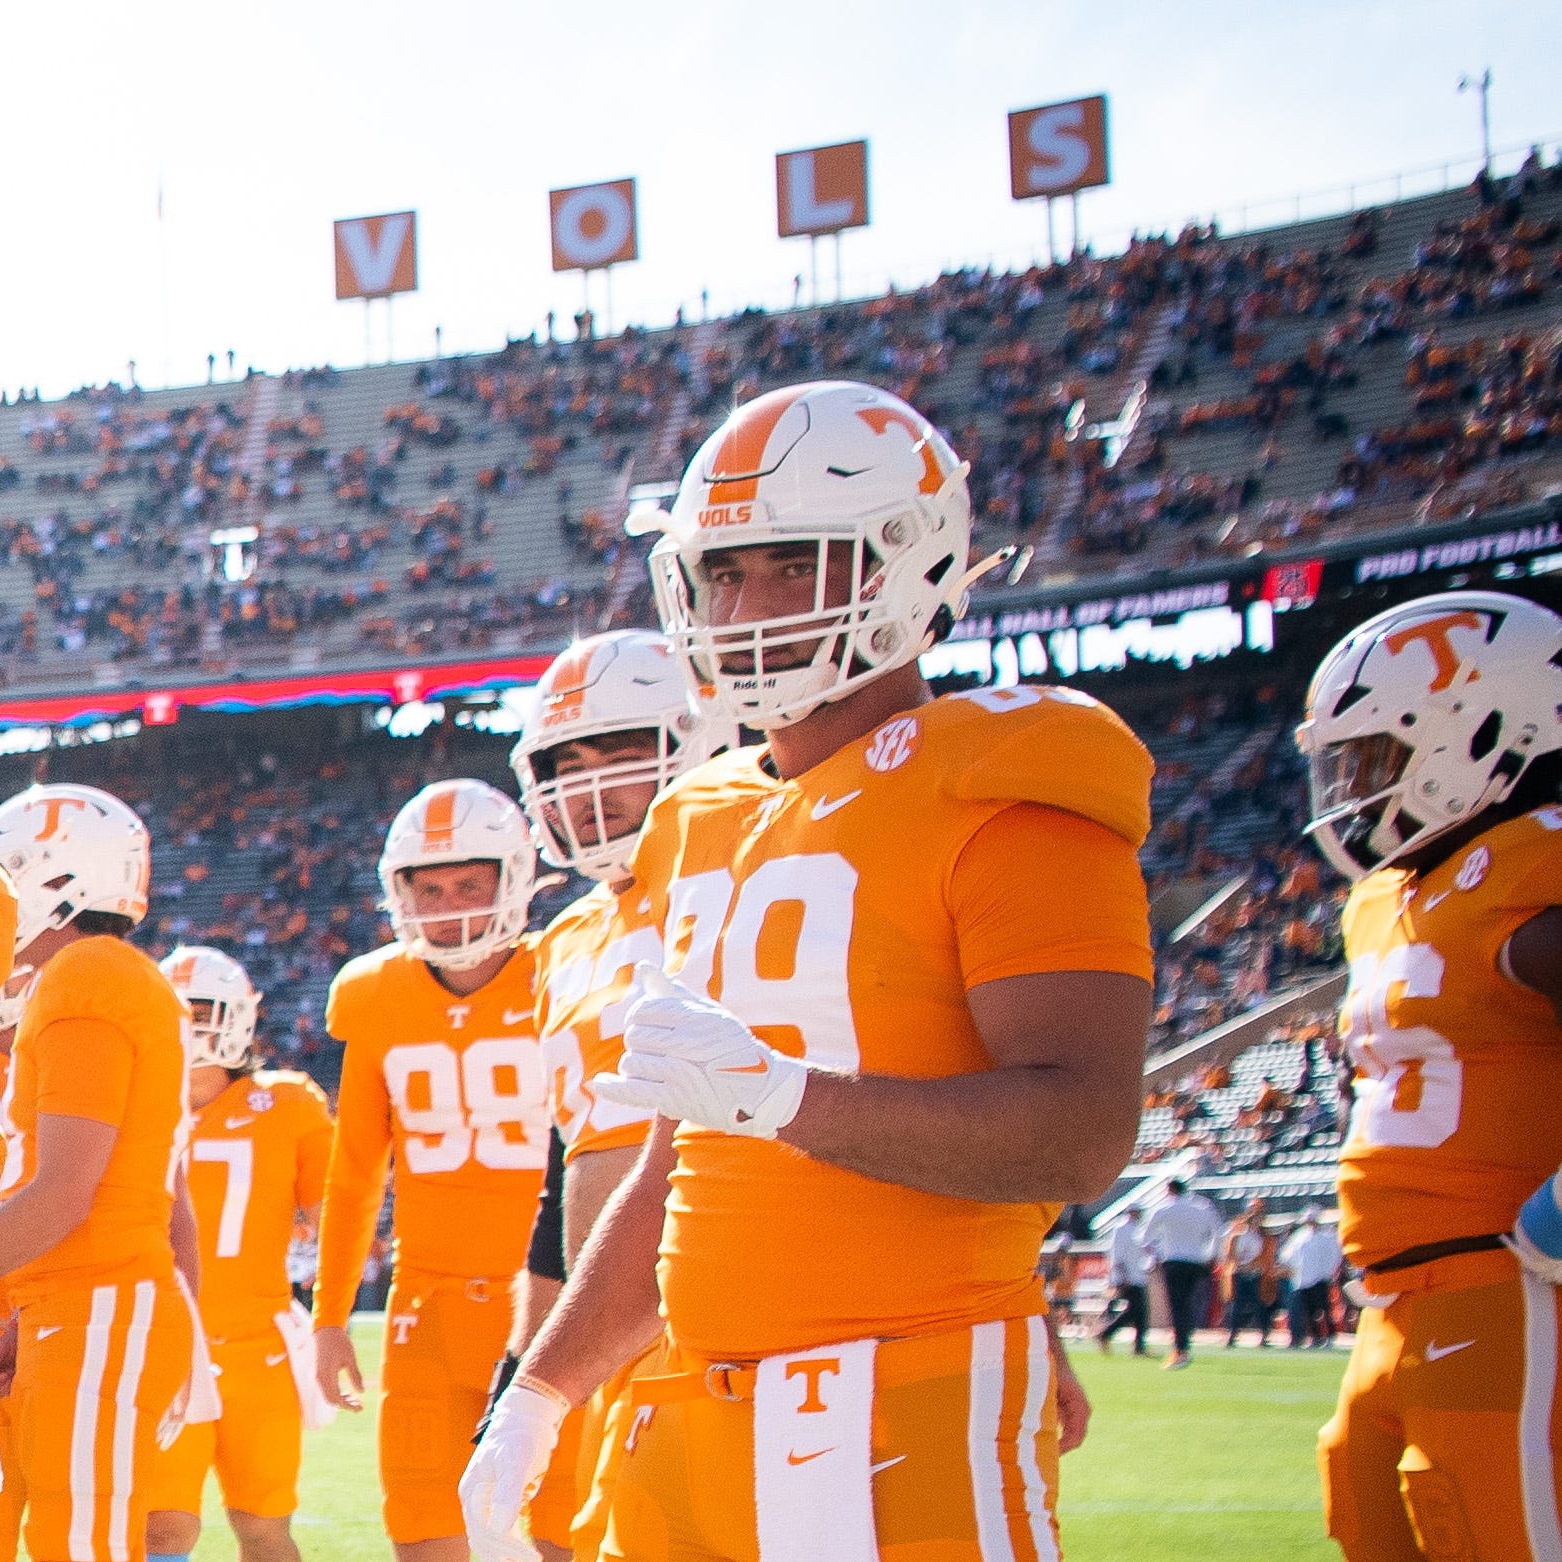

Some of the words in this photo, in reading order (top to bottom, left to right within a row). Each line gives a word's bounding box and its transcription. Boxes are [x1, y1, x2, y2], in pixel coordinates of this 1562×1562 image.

[697, 503, 752, 529] VOLS
[1356, 549, 1419, 585] PRO
[1384, 609, 1482, 694] T
[867, 719, 917, 773] SEC
[445, 1003, 472, 1030] T
[384, 1036, 554, 1174] 98
[392, 1313, 418, 1345] T
[785, 1358, 841, 1414] T
